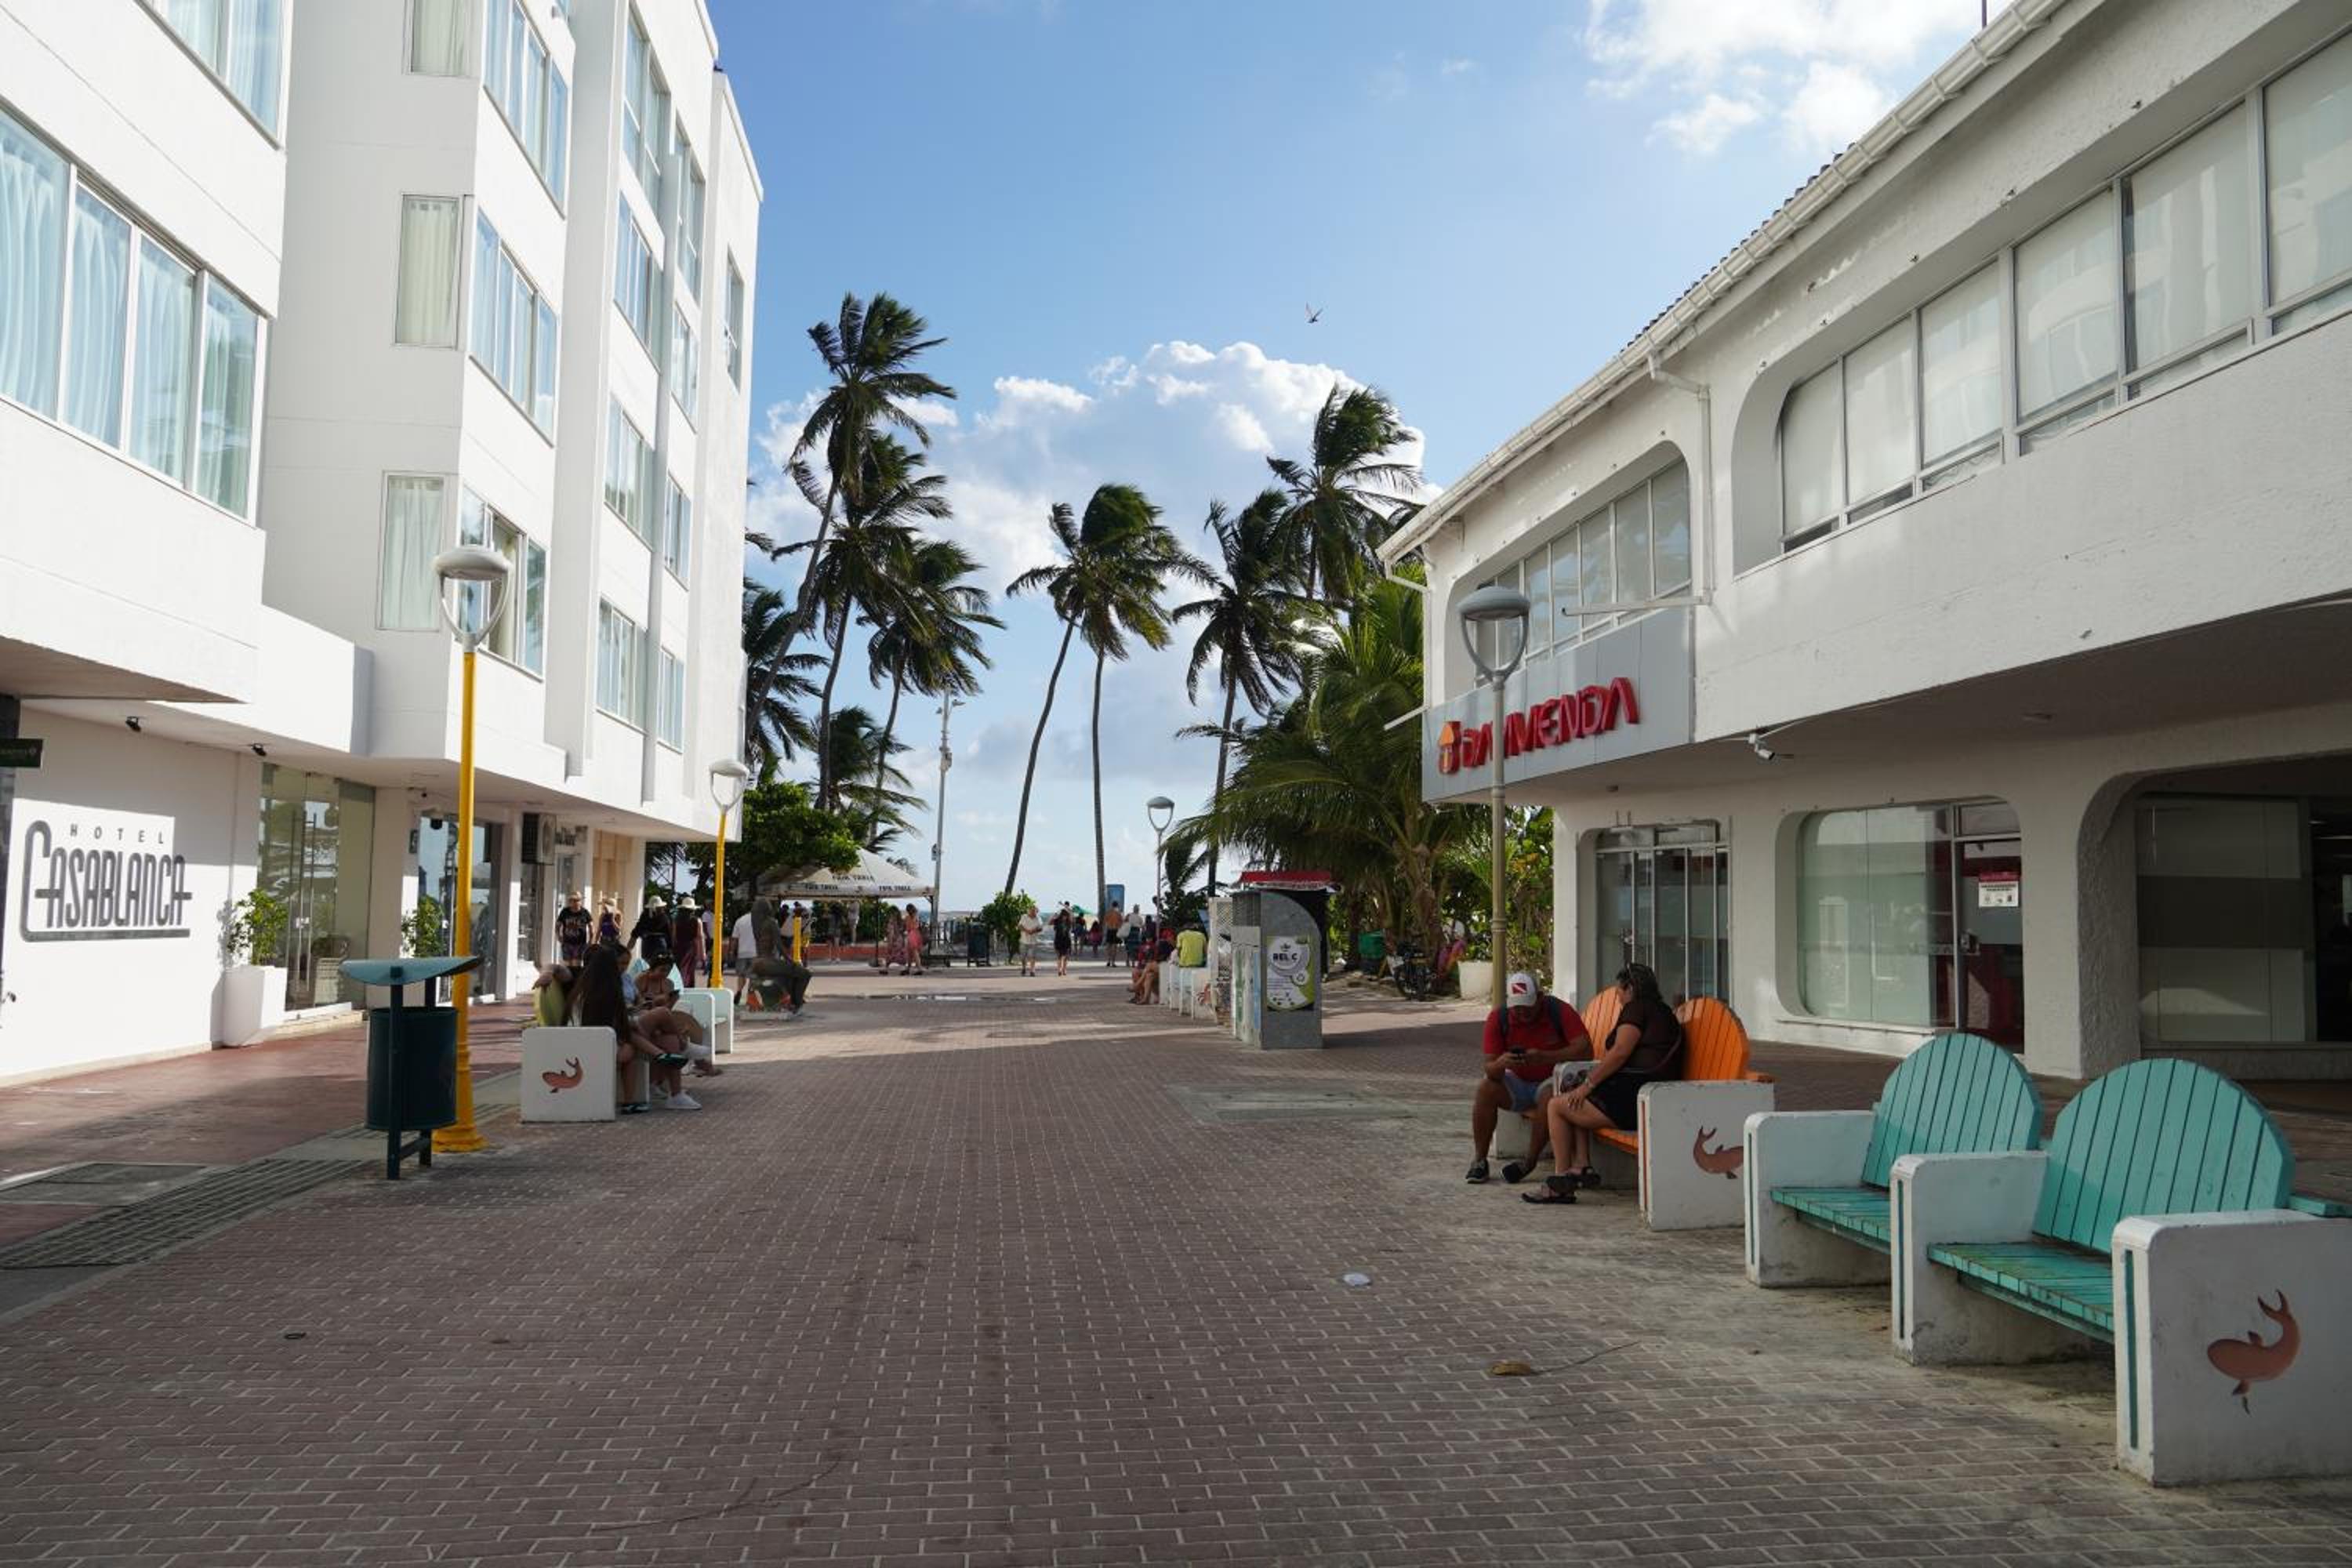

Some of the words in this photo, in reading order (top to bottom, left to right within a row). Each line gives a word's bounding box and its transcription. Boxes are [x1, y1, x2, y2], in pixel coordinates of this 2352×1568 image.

[1459, 677, 1639, 768] DAIVIENDA
[70, 824, 164, 844] HOTEL
[20, 820, 192, 942] CASABLANCA
